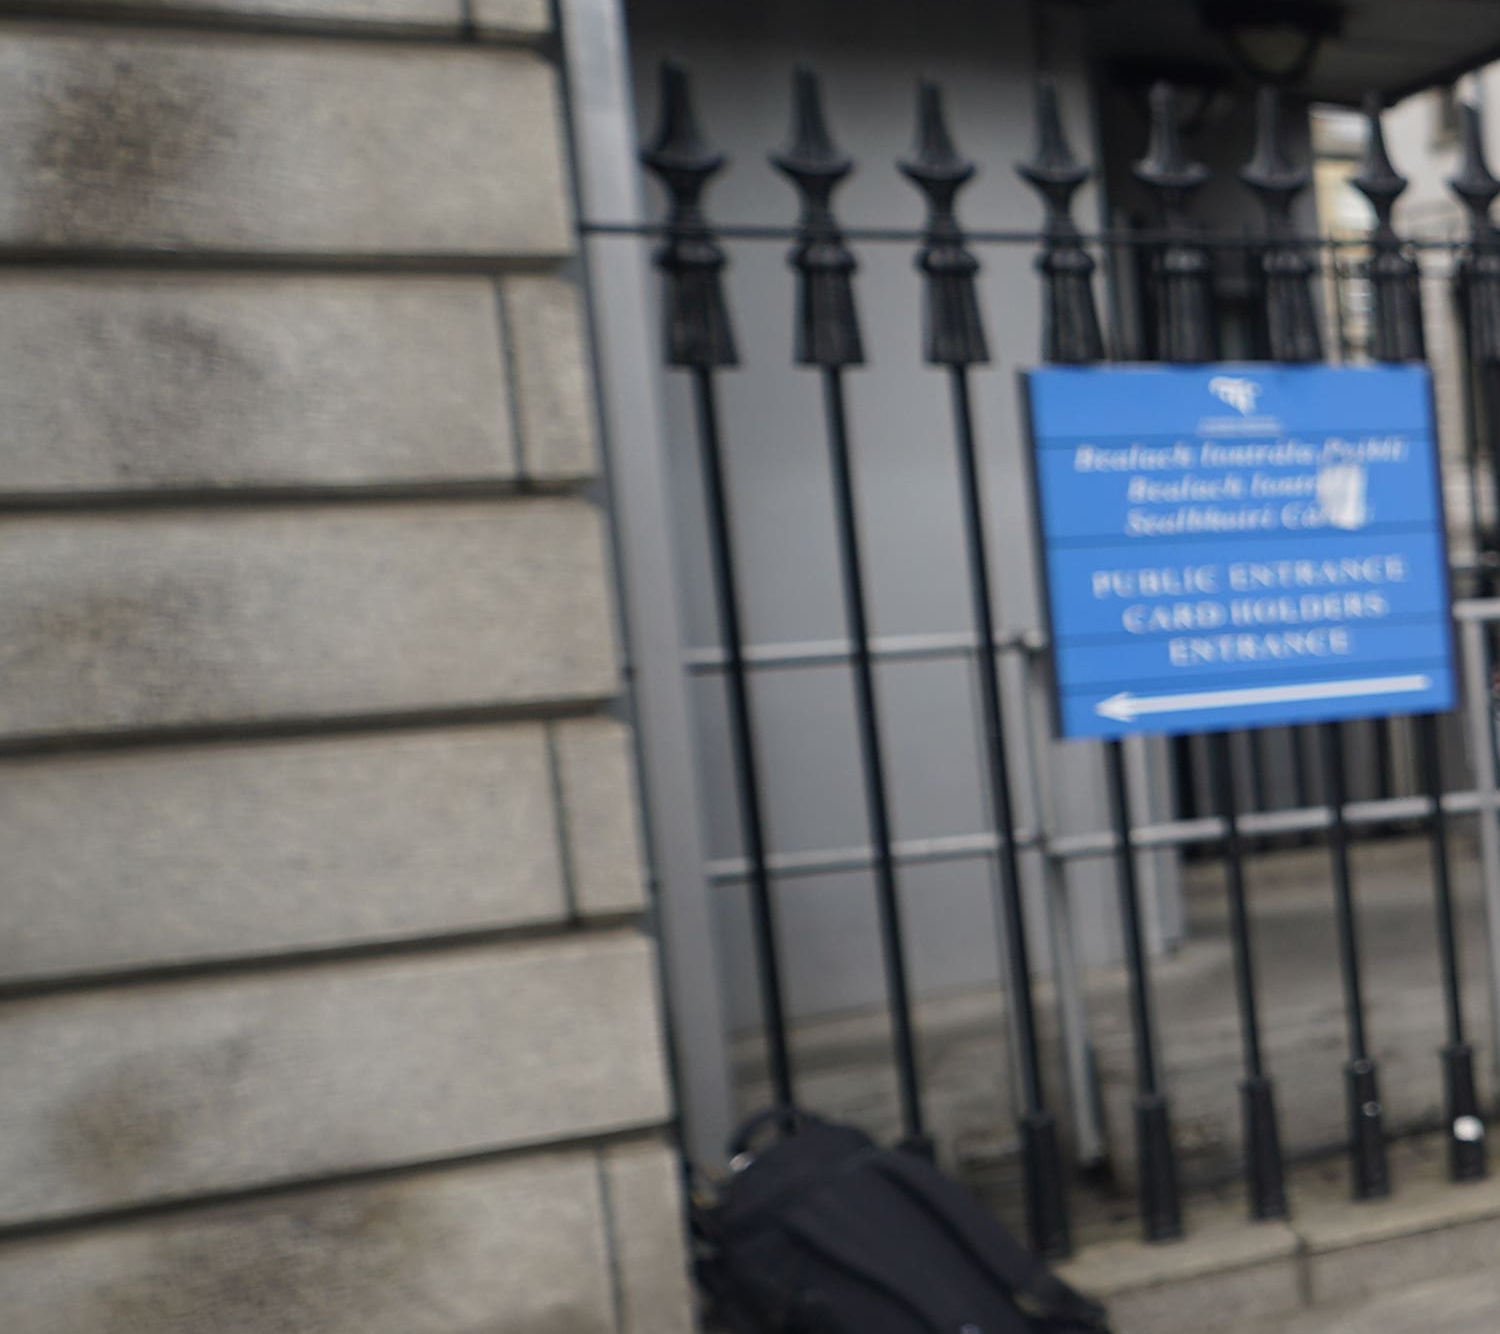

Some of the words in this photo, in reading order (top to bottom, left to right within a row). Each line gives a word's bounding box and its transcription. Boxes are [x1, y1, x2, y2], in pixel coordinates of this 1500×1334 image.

[1074, 444, 1192, 472] Bealach
[1127, 475, 1242, 503] Bealach
[1092, 564, 1218, 600] PUBLIC
[1228, 554, 1405, 592] ENTRANCE
[1168, 625, 1352, 667] ENTRANCE
